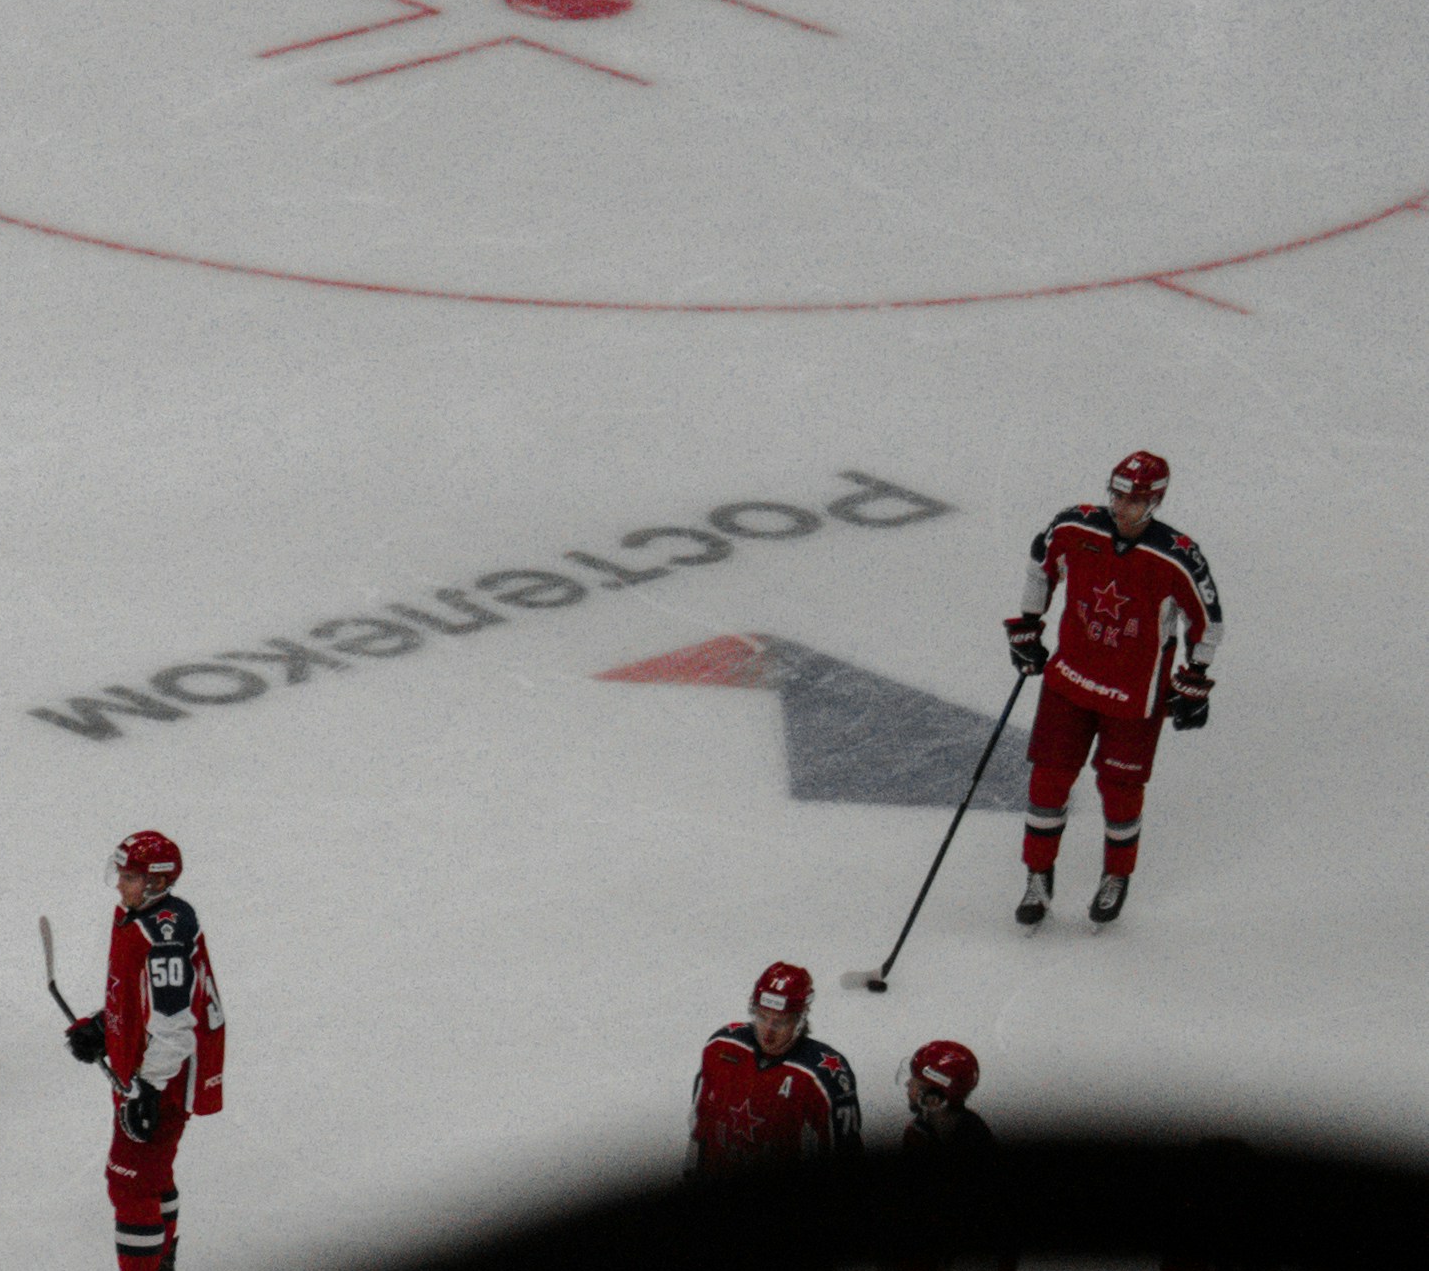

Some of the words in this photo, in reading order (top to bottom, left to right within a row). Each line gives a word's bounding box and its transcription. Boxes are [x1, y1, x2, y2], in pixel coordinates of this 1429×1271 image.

[28, 468, 961, 742] Ростелеком
[150, 956, 184, 989] 50
[773, 1076, 791, 1101] A
